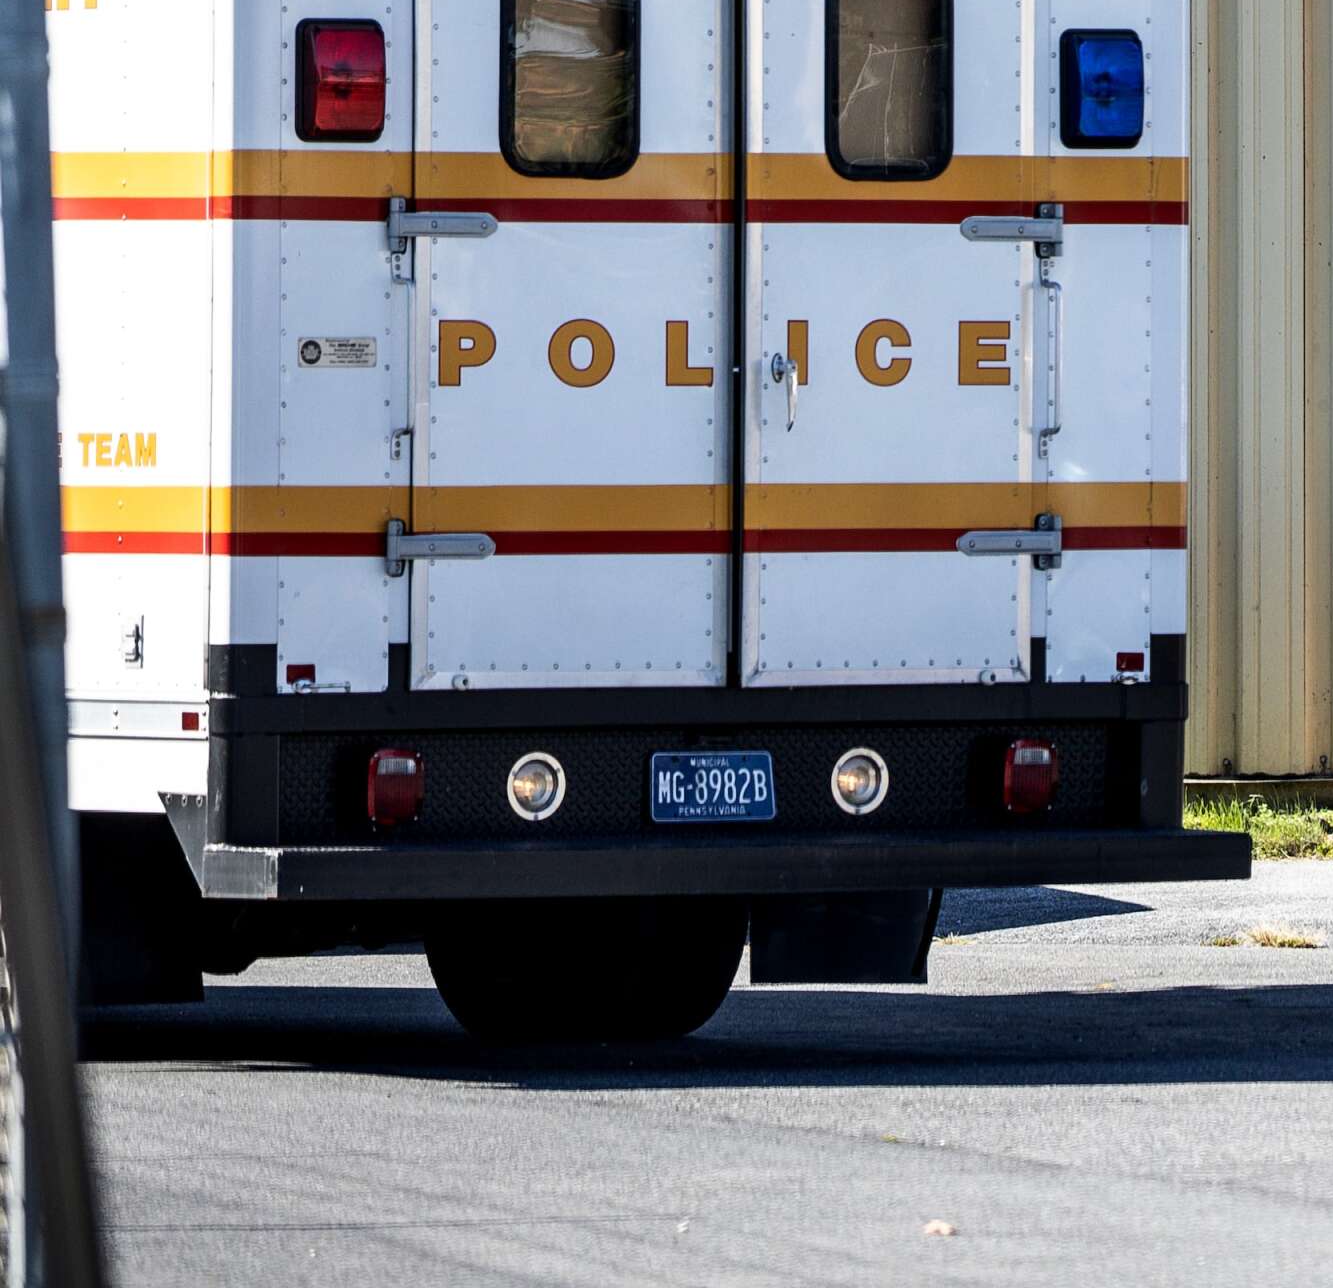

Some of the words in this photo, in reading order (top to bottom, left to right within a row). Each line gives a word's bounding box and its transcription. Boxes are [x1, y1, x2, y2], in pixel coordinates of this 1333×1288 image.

[438, 319, 1011, 387] POLICE
[78, 432, 157, 467] TEAM
[690, 757, 730, 767] MUNICIPAL
[658, 768, 767, 804] MG-8982B
[678, 806, 746, 816] PENNSYLVANIA
